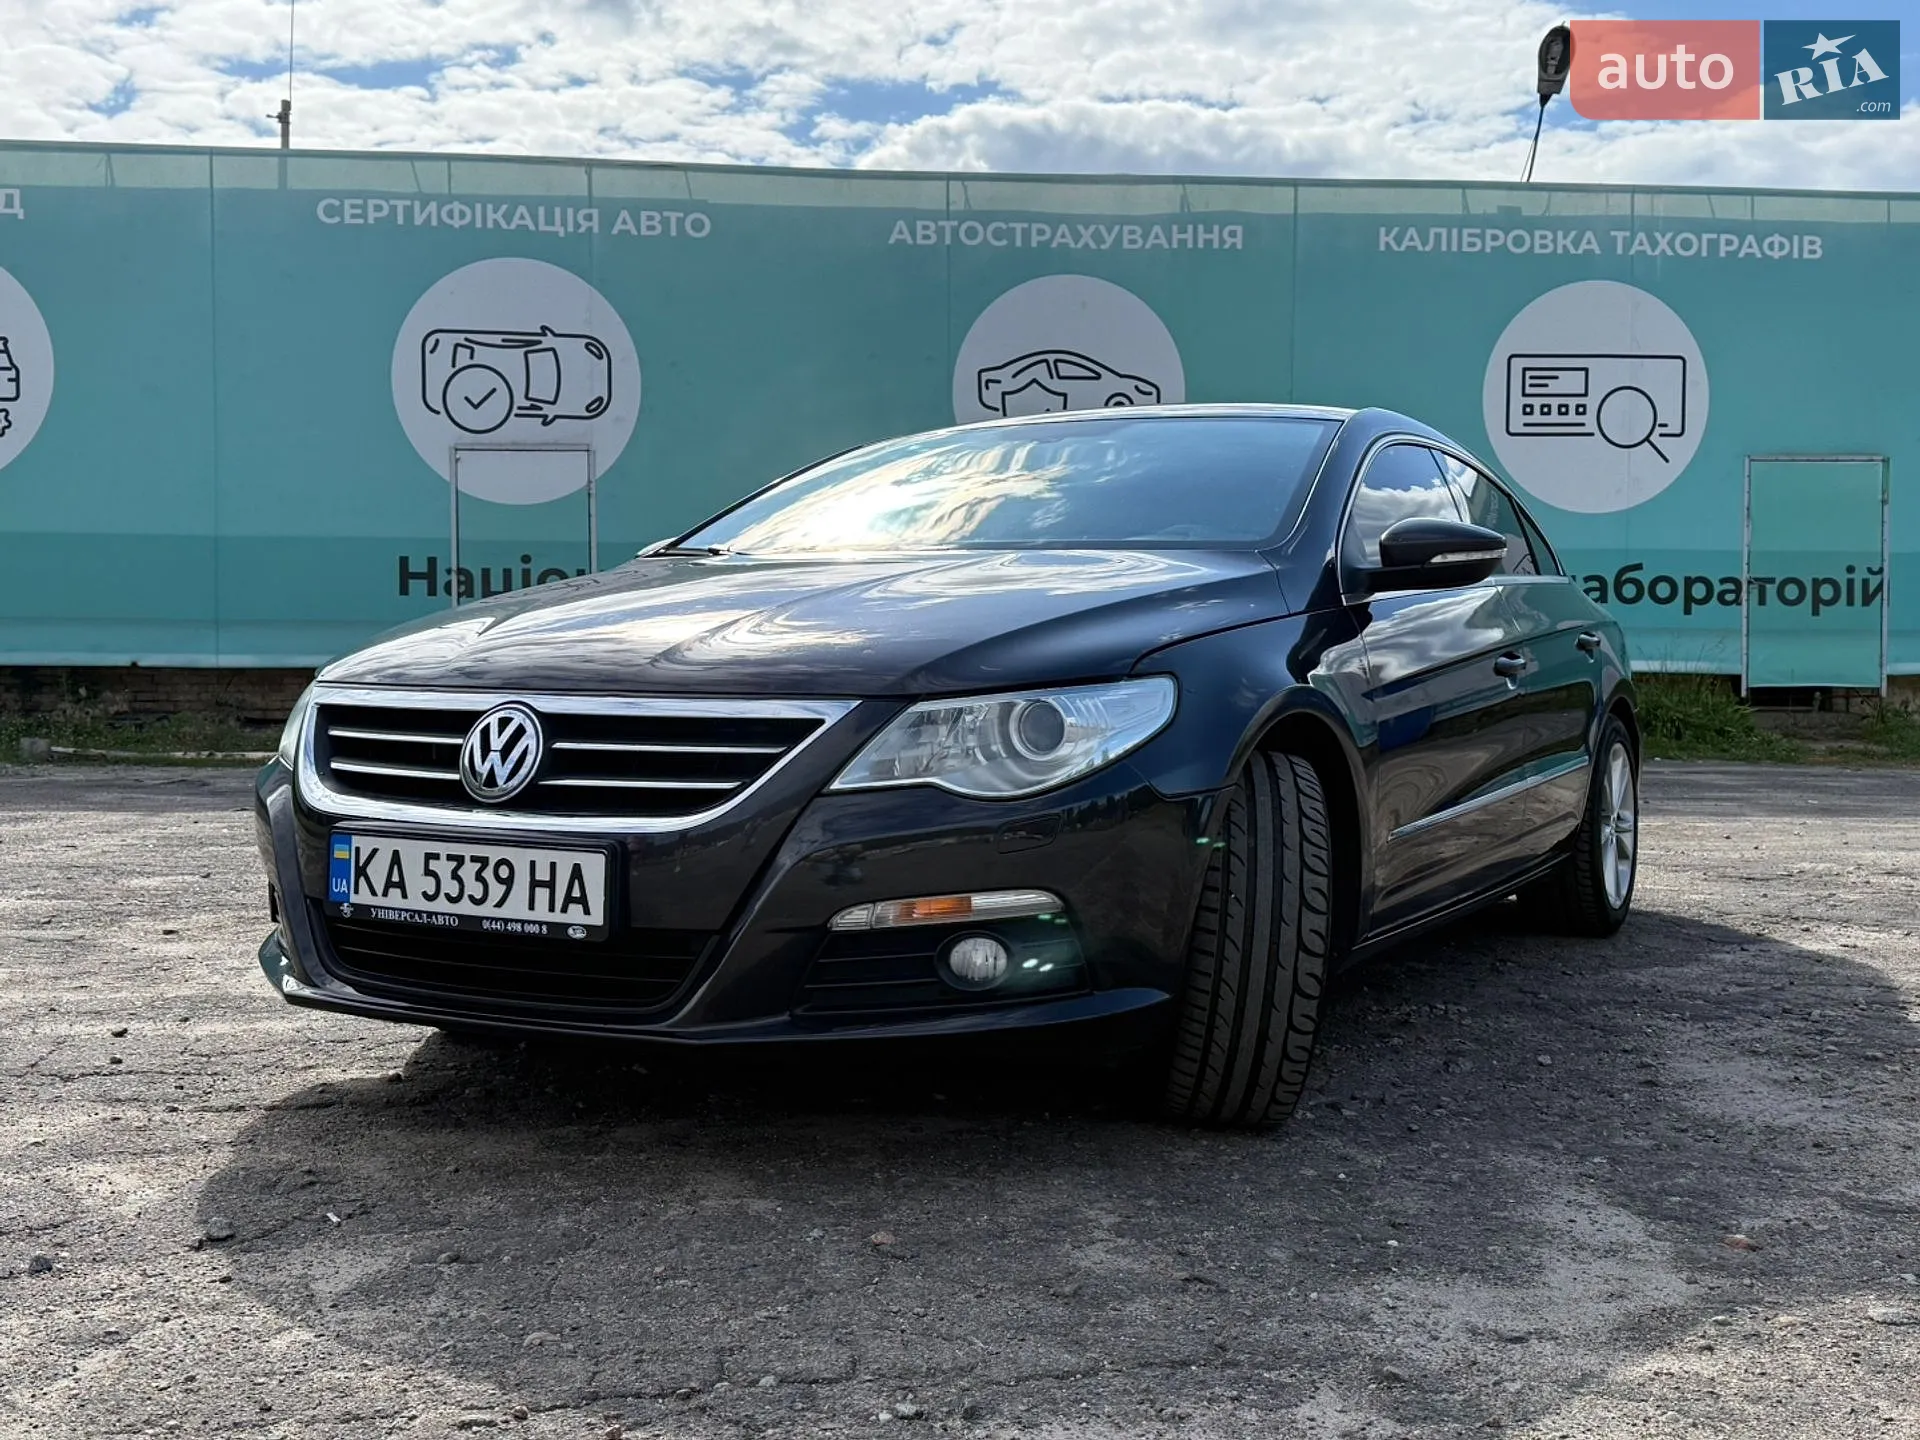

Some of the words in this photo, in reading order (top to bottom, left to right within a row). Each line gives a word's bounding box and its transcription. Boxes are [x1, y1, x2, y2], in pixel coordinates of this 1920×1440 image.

[316, 198, 600, 237] СЕРТИФІКАЦІЯ
[611, 209, 712, 238] АВТО
[888, 219, 1244, 250] АВТОСТРАХУВАННЯ
[1378, 226, 1601, 256] КАЛІБРОВКА
[1609, 229, 1823, 260] ТАХОГРАФІВ
[1570, 562, 1889, 617] абораторій
[332, 876, 349, 895] UA
[421, 851, 515, 908] 5339
[370, 907, 459, 927] УНІВЕРСАЛ-АВТО
